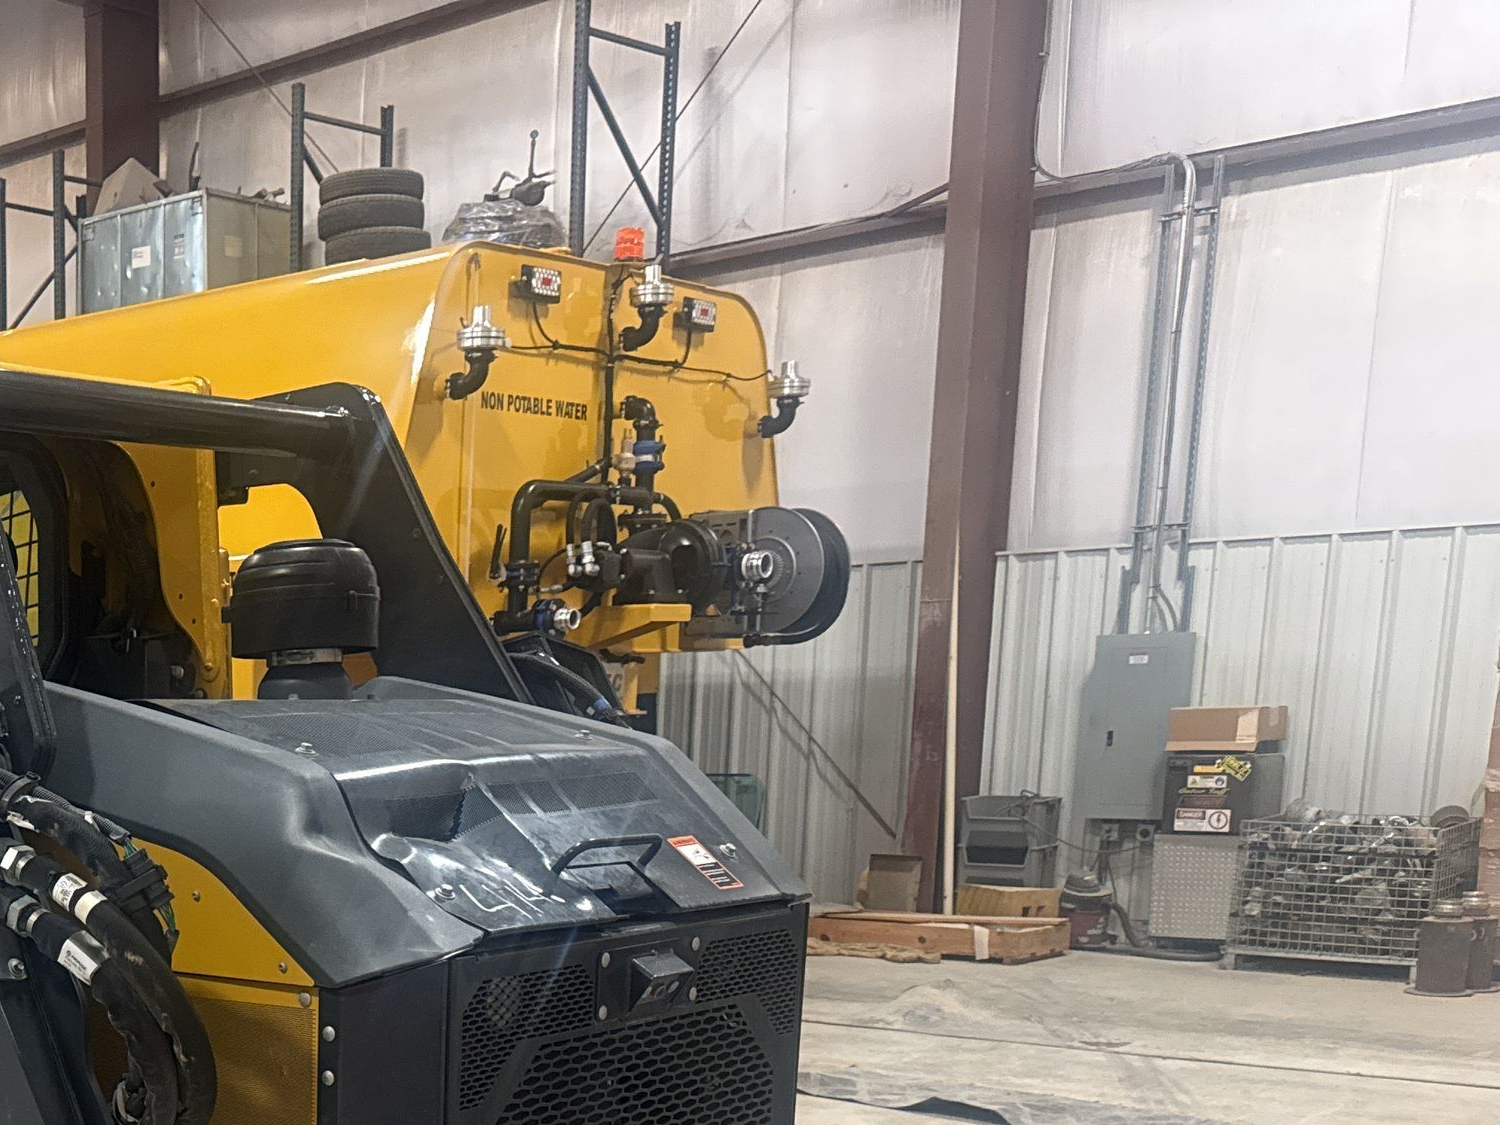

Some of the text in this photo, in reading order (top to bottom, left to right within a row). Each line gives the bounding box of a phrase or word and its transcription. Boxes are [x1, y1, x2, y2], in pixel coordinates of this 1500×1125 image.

[481, 391, 588, 421] NON POTABLE WATER
